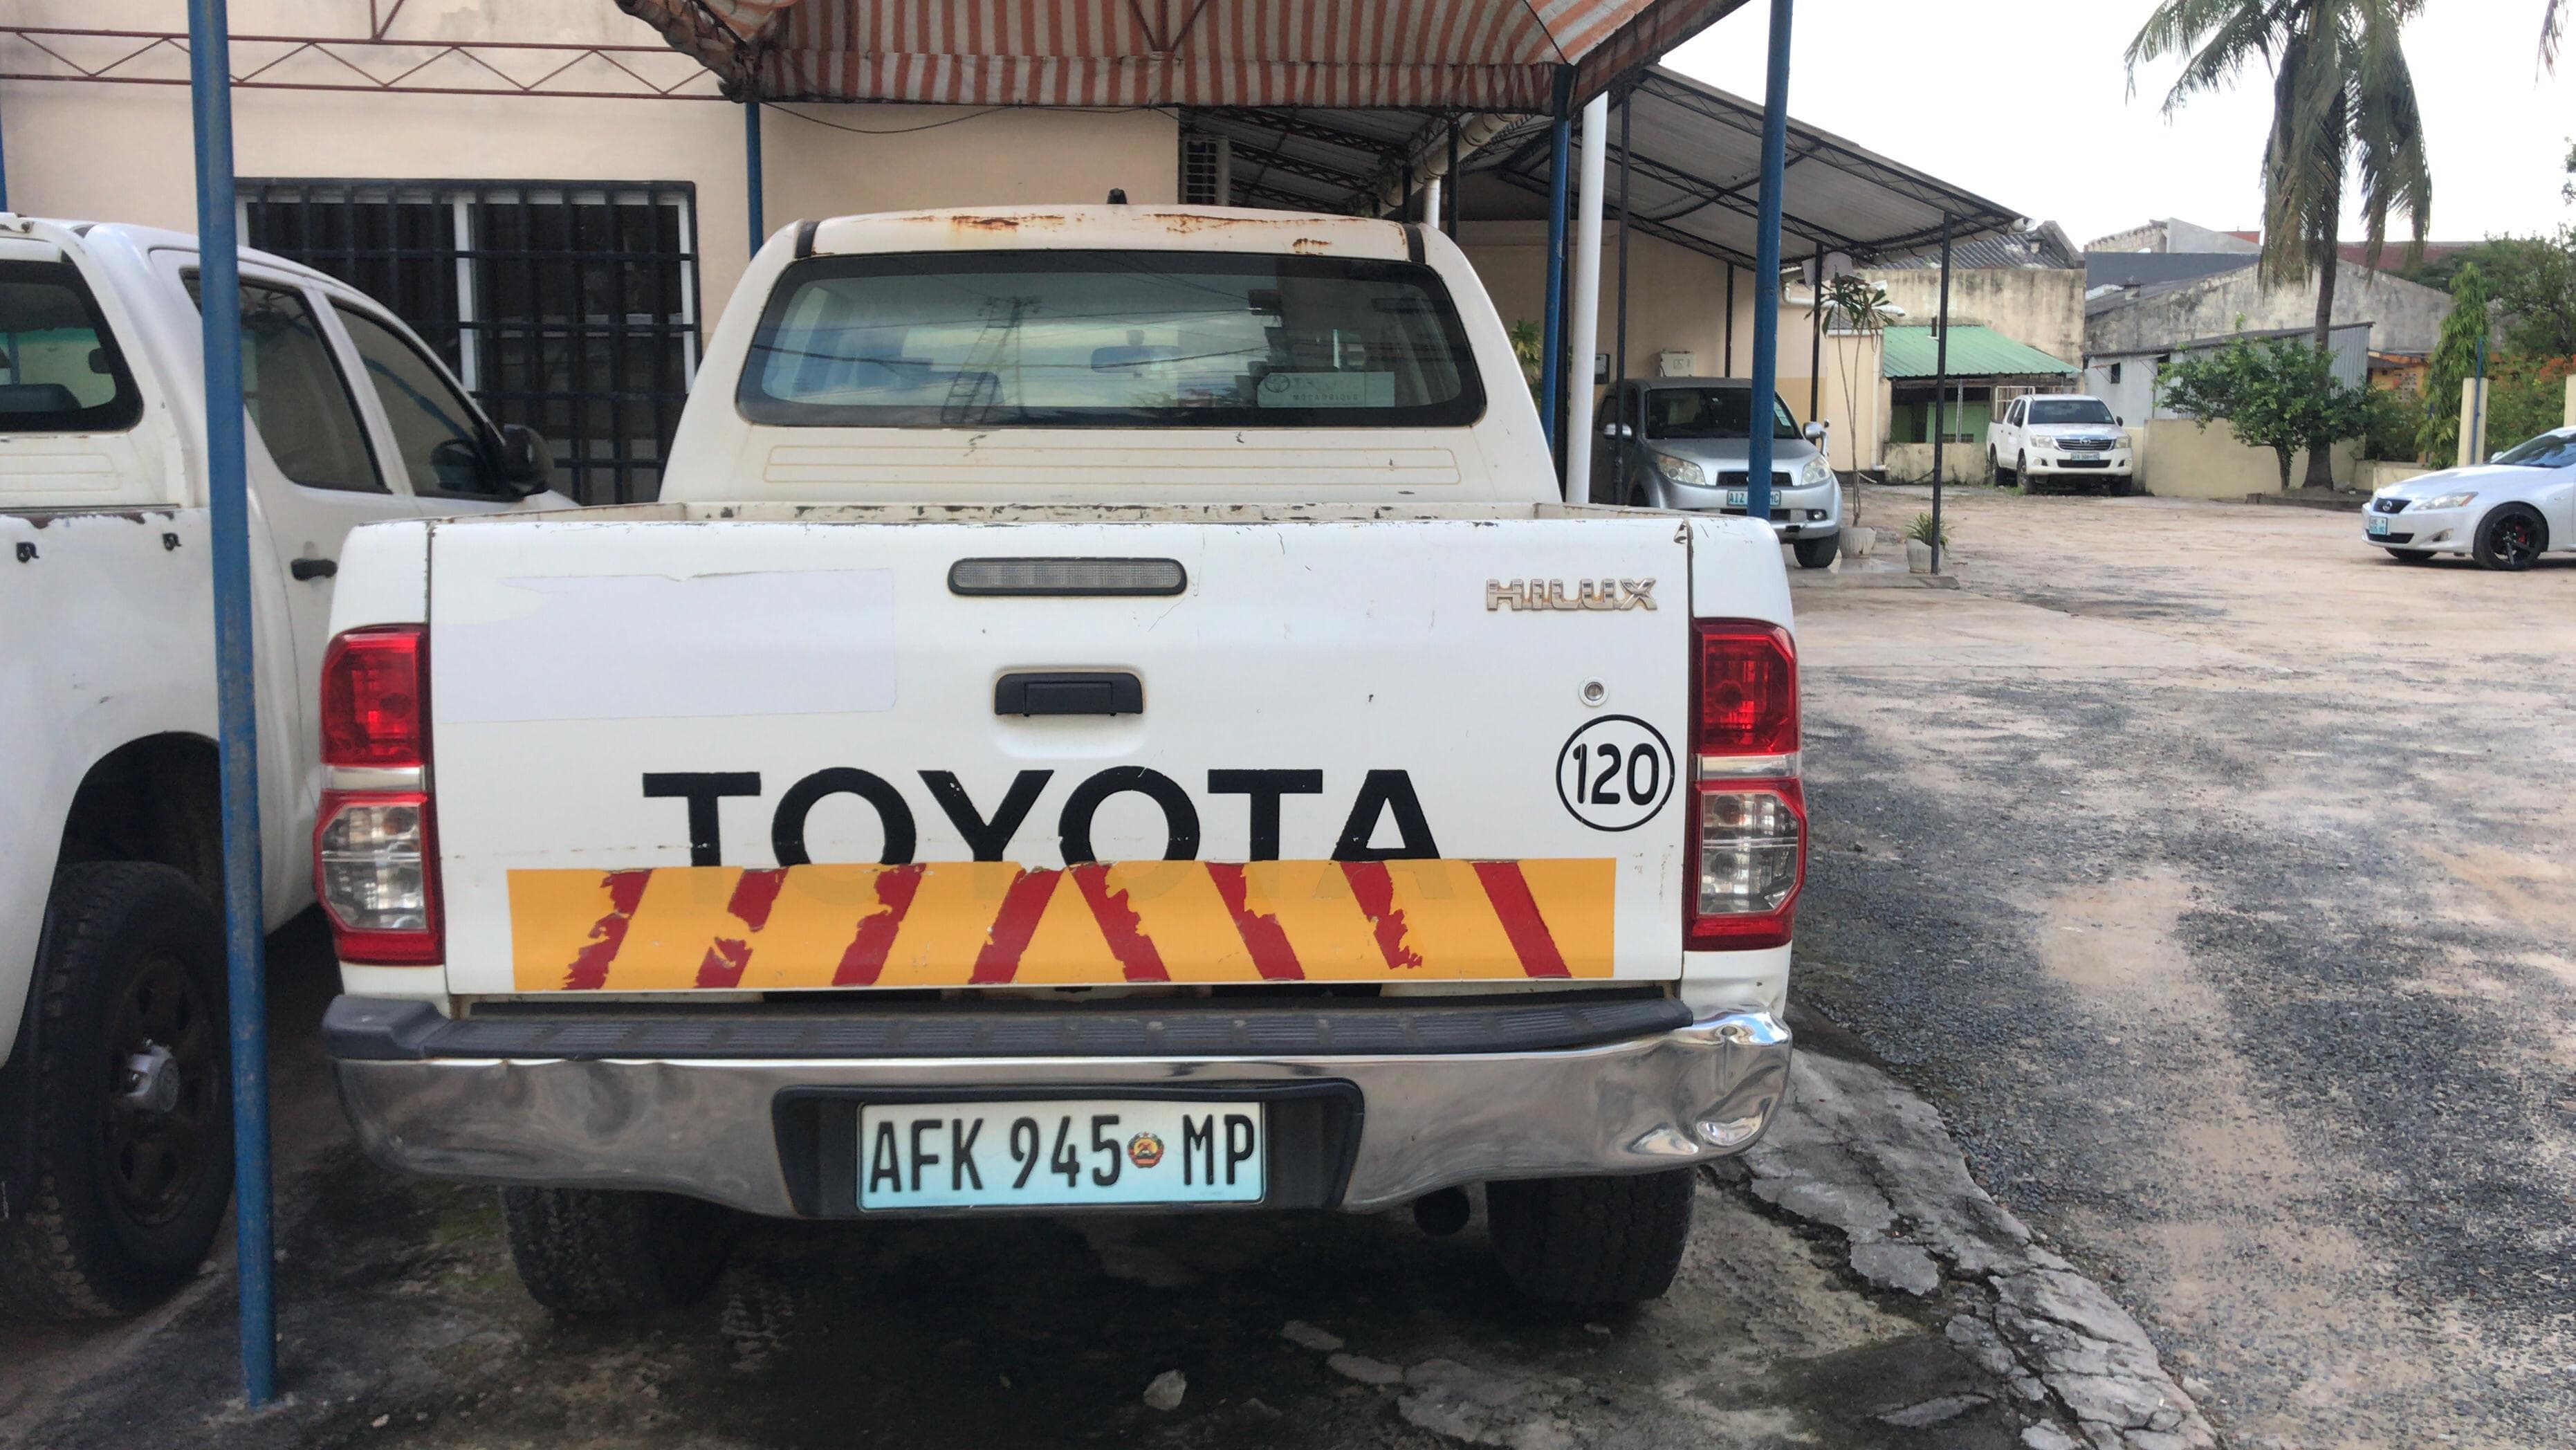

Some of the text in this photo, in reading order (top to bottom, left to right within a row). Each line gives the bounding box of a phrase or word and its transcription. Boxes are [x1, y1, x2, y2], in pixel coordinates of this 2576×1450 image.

[1485, 578, 1658, 612] HILUX
[1572, 742, 1660, 806] 120
[642, 765, 1442, 868] TOYOTA
[870, 1114, 1255, 1193] AFK 945 MP
